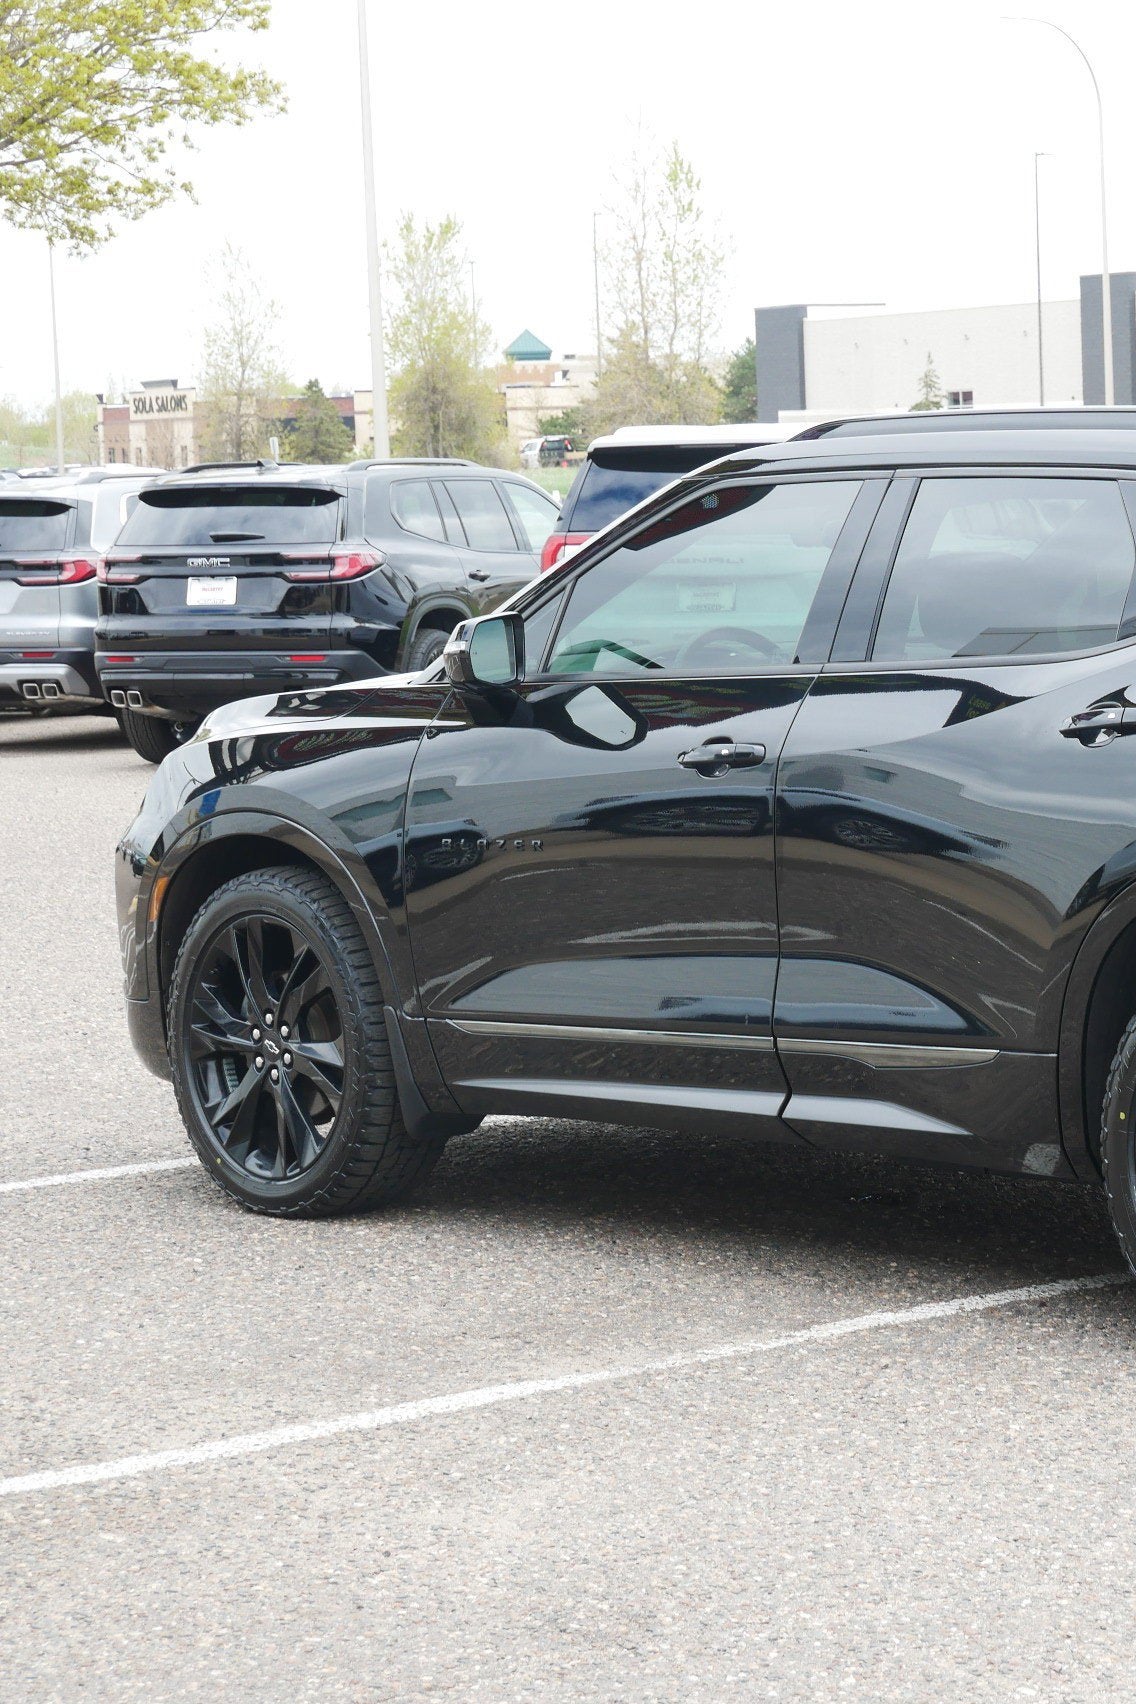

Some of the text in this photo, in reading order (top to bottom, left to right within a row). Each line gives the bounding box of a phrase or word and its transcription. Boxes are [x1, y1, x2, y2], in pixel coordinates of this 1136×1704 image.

[133, 394, 188, 414] SOLA SALONS
[187, 557, 230, 568] GMC
[442, 838, 544, 851] BLAZER
